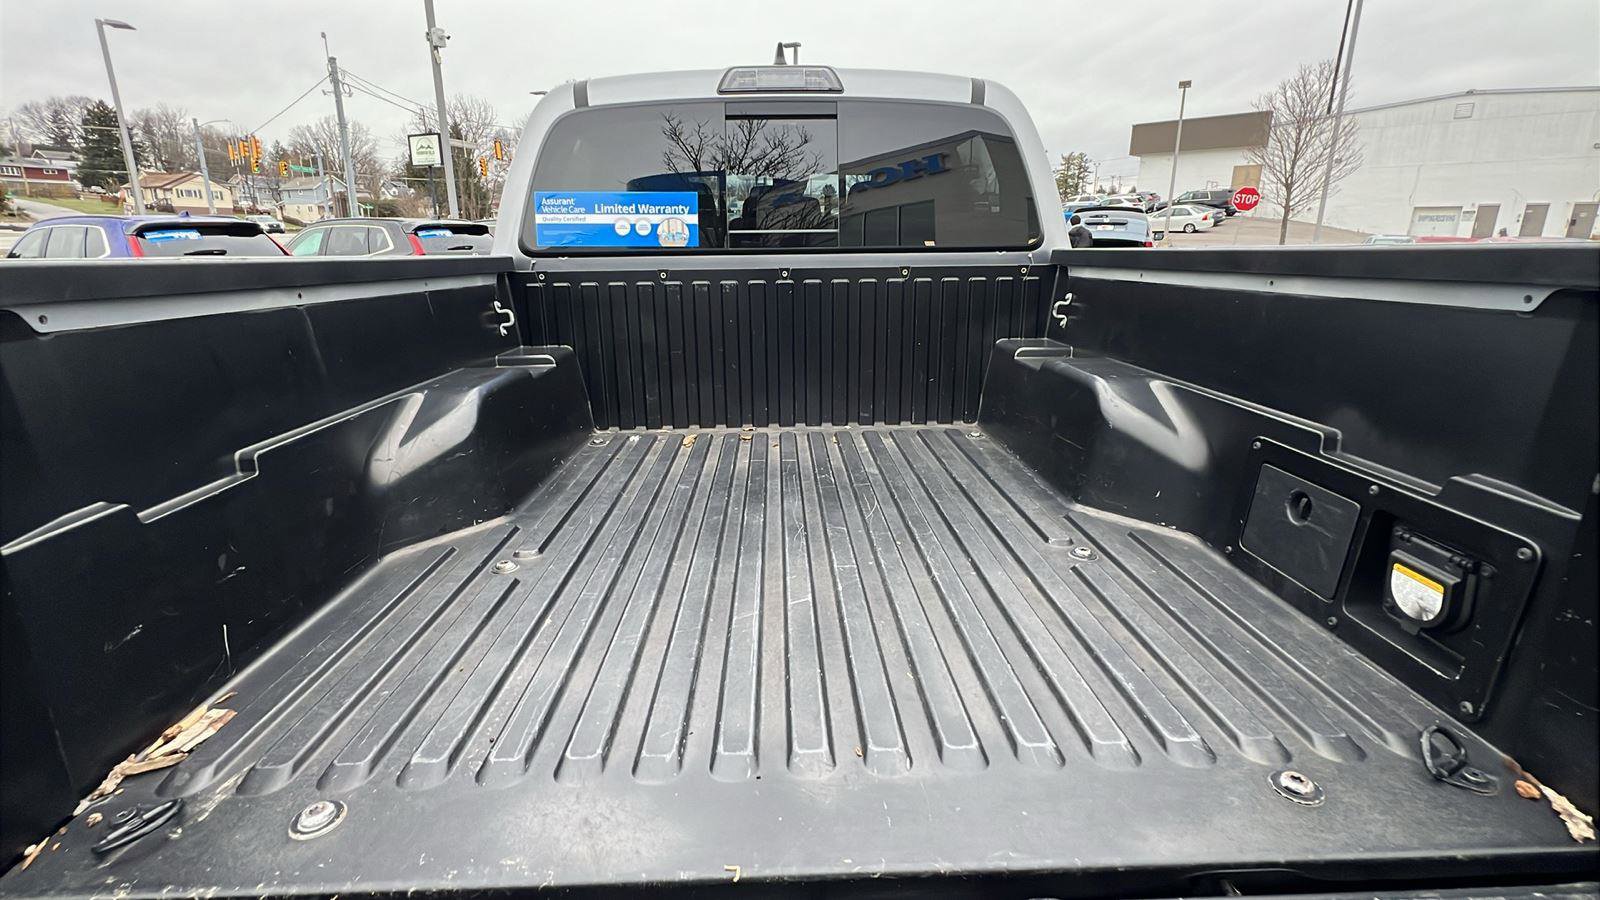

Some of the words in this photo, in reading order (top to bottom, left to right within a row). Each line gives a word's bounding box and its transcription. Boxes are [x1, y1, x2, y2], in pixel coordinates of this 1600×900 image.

[541, 197, 575, 205] Assurant
[1234, 193, 1259, 204] STOP
[594, 203, 636, 214] Limited
[637, 203, 690, 215] Warranty
